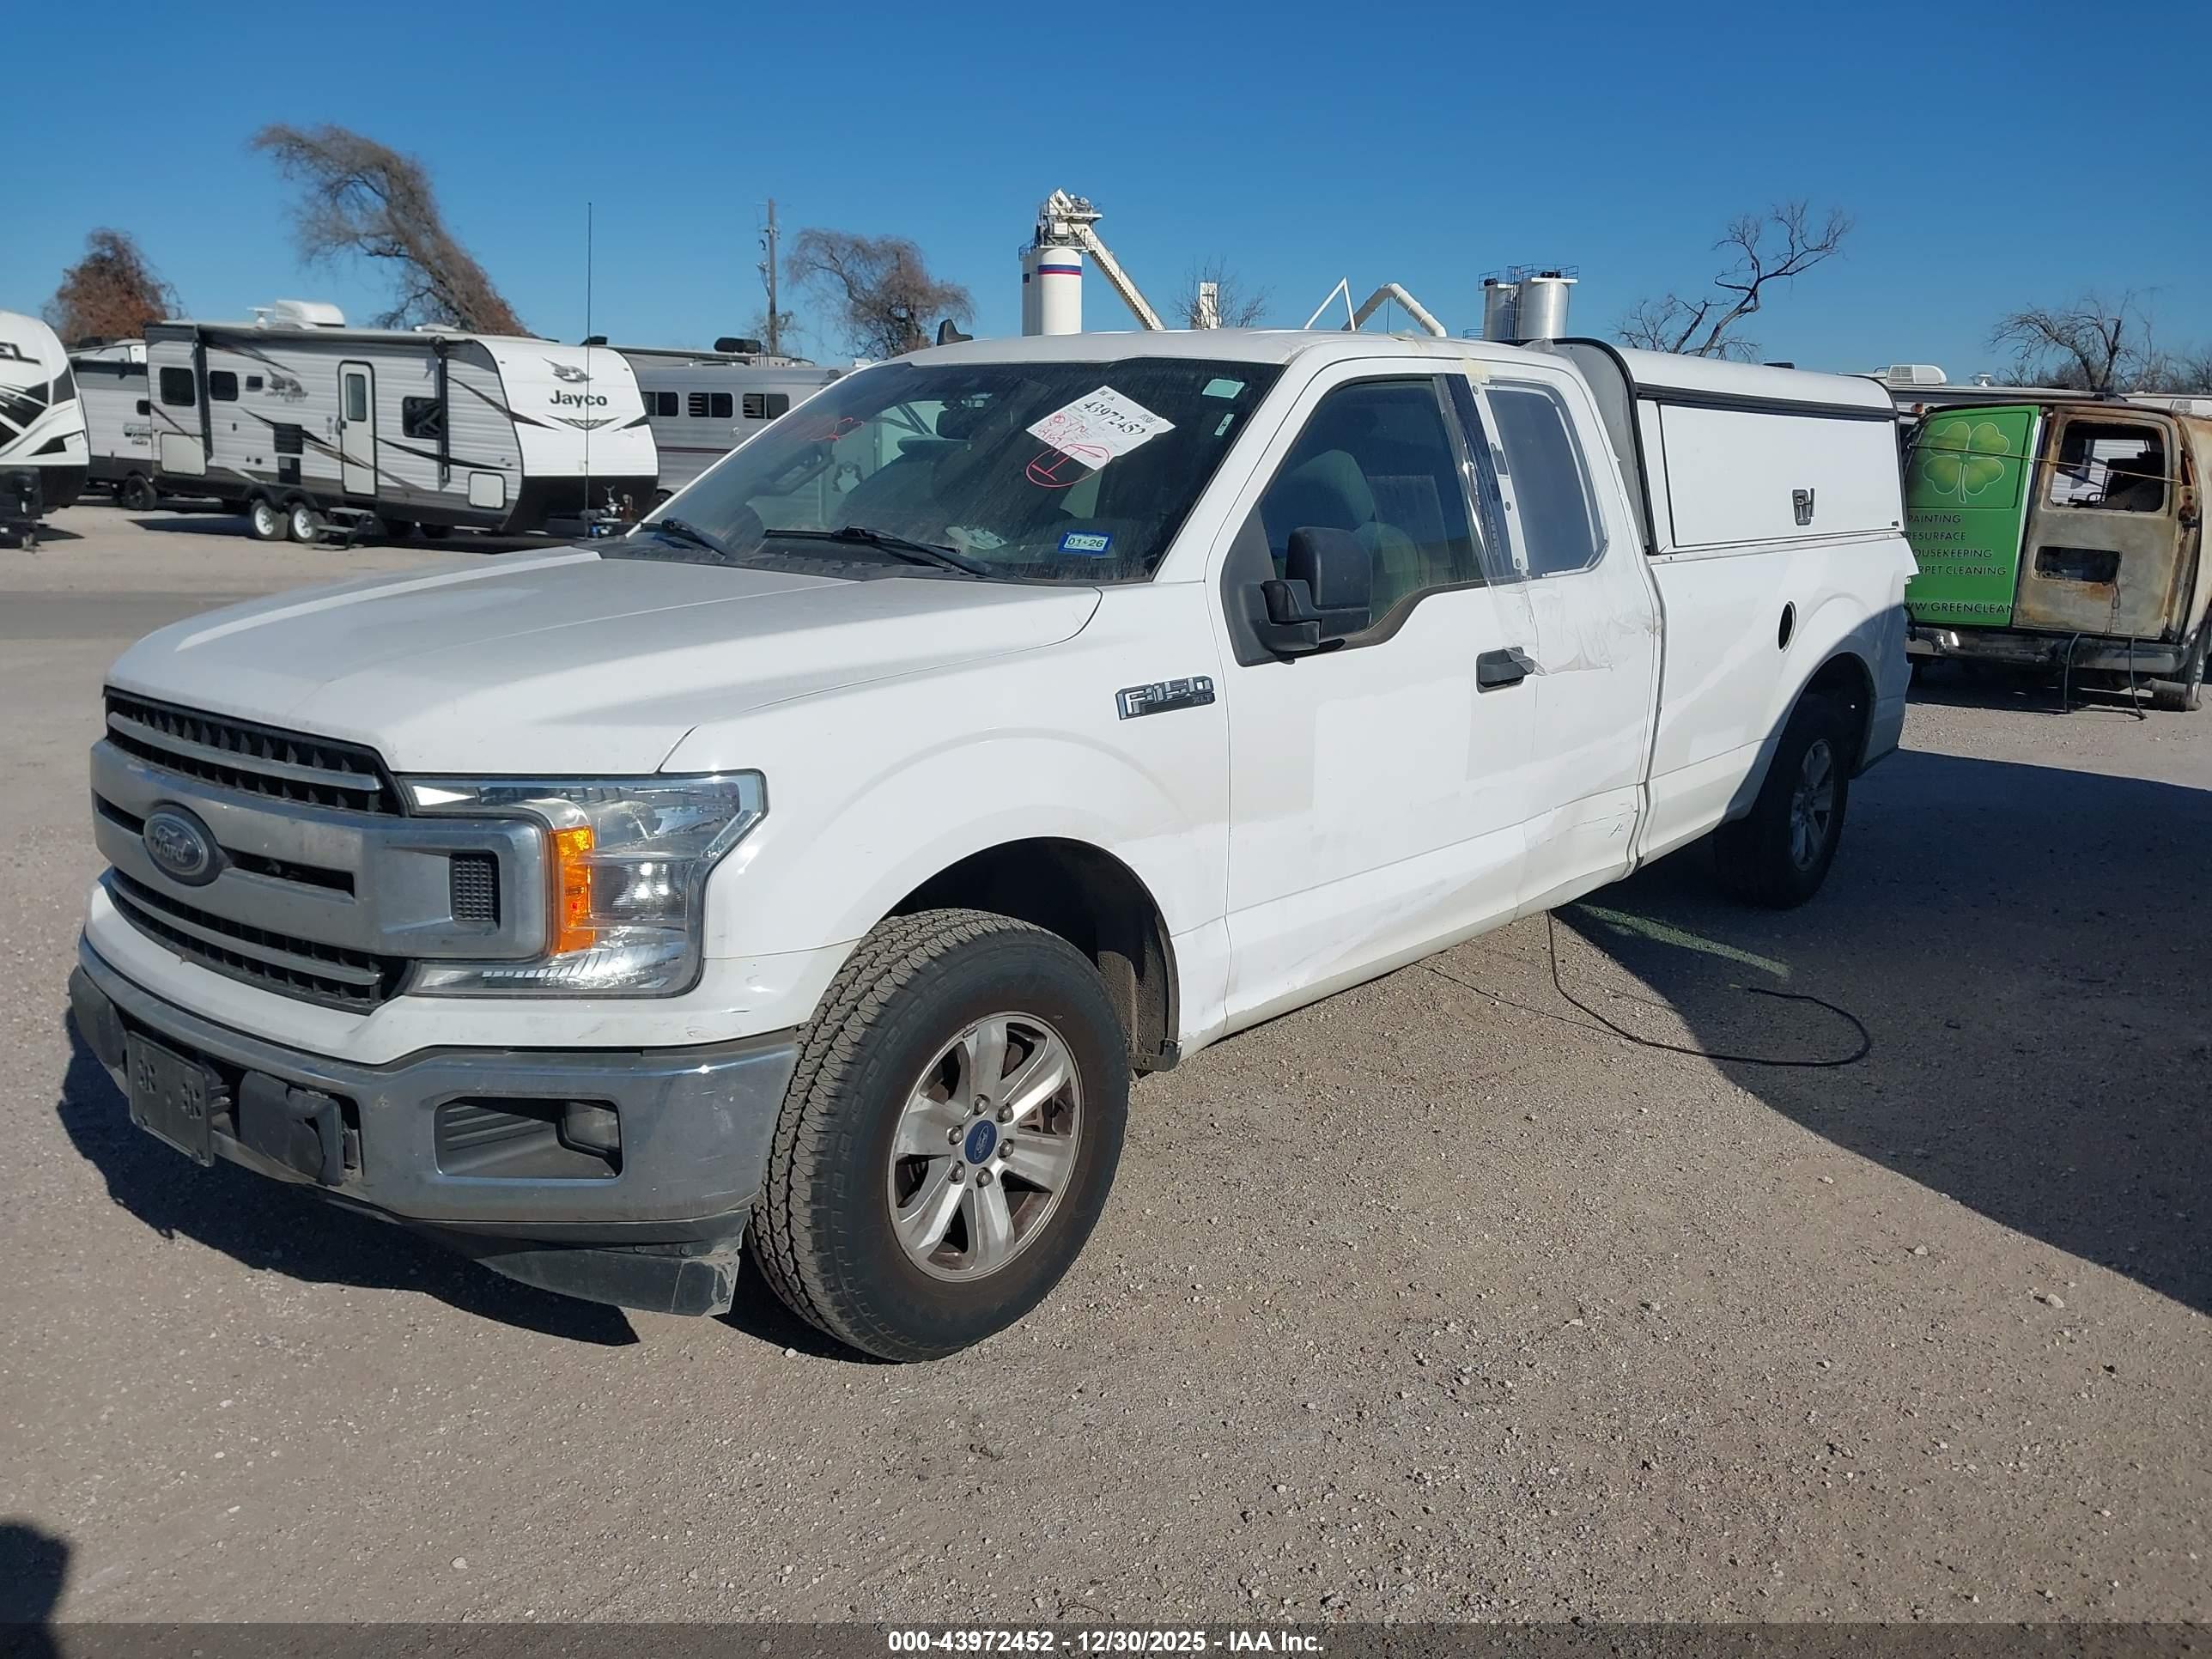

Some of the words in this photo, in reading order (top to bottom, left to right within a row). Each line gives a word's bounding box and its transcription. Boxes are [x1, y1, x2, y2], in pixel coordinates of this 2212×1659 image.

[550, 390, 608, 409] Jayco
[1083, 401, 1147, 436] 43972452
[1907, 514, 1962, 524] PAINTING
[1905, 532, 1966, 541] RESURFACE
[1913, 549, 1993, 558] OUSEKEEPING
[1917, 565, 1943, 575] RPET
[1945, 565, 2007, 576] CLEANING
